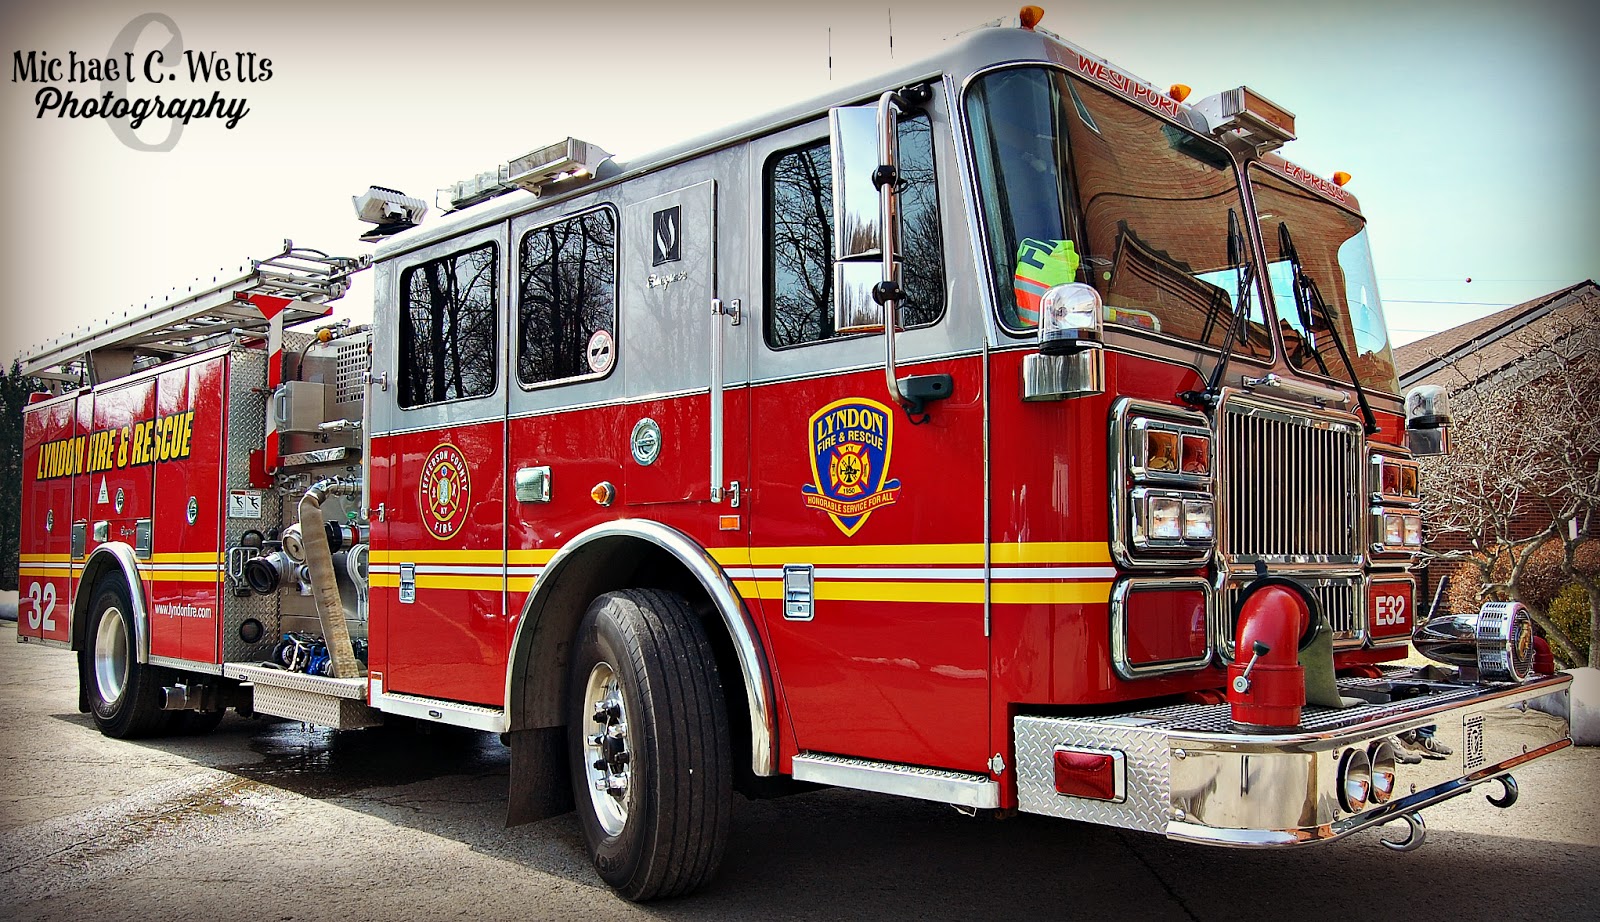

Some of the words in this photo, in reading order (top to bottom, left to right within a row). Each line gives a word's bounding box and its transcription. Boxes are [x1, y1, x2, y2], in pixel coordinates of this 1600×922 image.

[817, 408, 884, 442] LYNDON
[36, 435, 86, 481] LYNDON
[86, 428, 117, 473] FIRE
[117, 425, 130, 468] &
[131, 410, 195, 466] RESCUE
[817, 433, 836, 455] FIRE
[838, 431, 846, 443] &
[848, 430, 884, 451] RESCUE
[422, 450, 449, 494] JEFFERSON
[450, 453, 468, 492] COUNTY
[807, 496, 842, 512] HONORABLE
[842, 501, 868, 513] SERVICE
[868, 495, 881, 508] FOR
[881, 492, 894, 502] ALL
[434, 521, 453, 534] FIRE
[27, 581, 57, 632] 32
[154, 602, 212, 619] www.lyndonfire.com
[1375, 595, 1405, 626] E32
